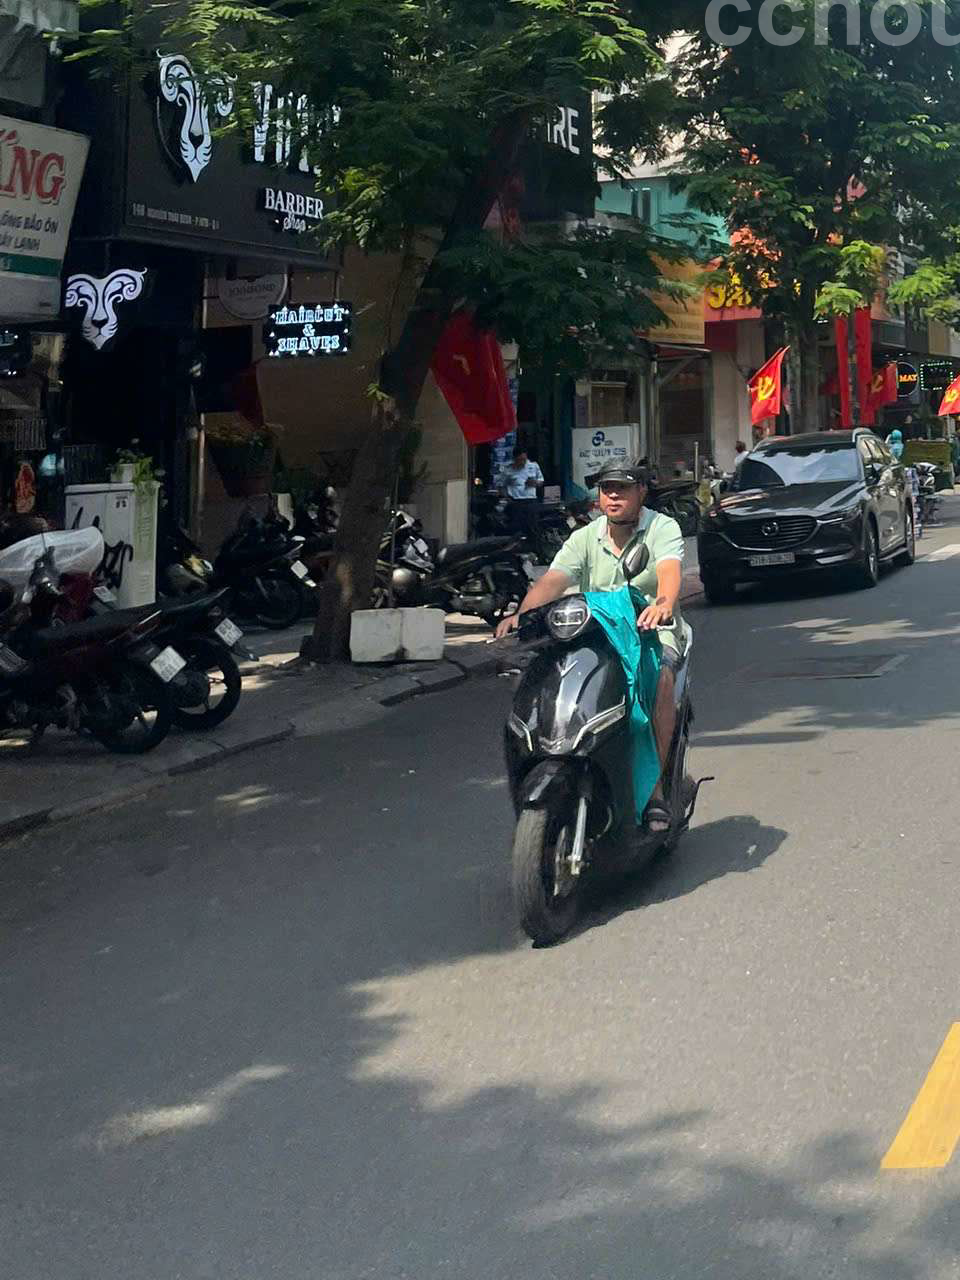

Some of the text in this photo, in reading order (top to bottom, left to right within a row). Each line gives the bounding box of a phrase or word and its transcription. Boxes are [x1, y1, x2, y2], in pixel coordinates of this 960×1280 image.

[264, 187, 324, 219] BARBER
[275, 307, 344, 324] HAIRCUT
[302, 323, 315, 337] &
[277, 335, 340, 352] SHAVES
